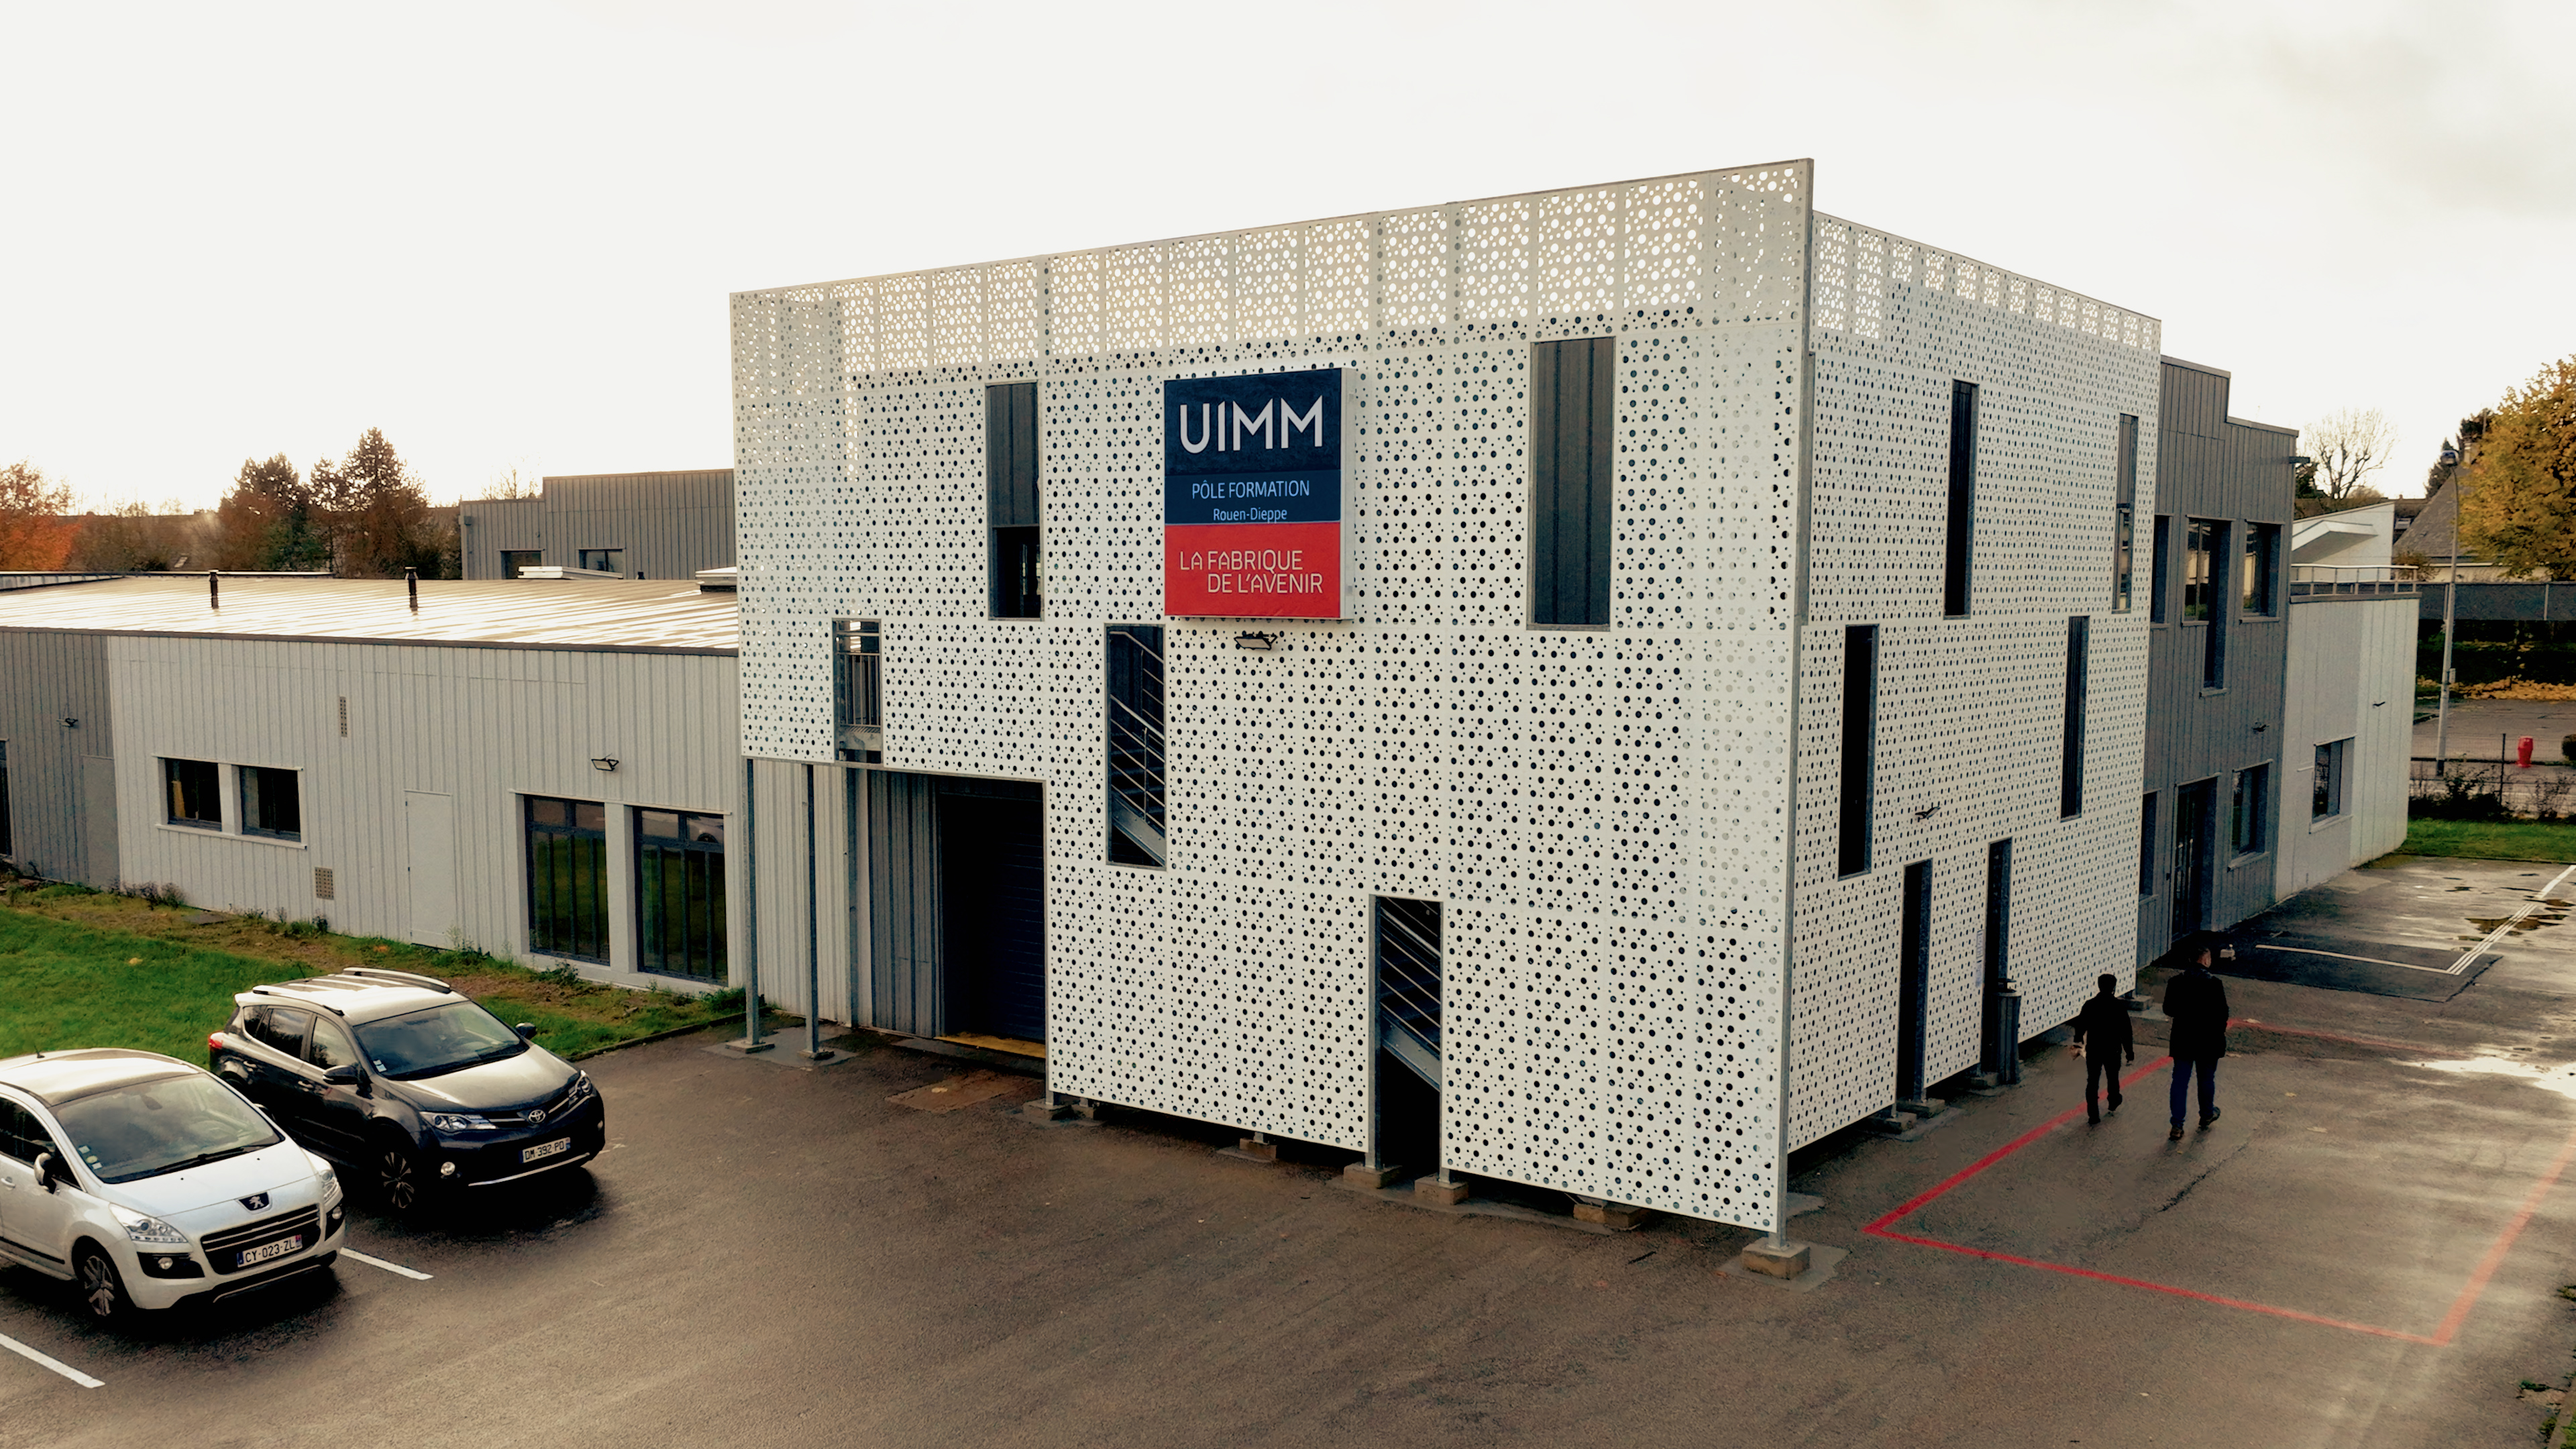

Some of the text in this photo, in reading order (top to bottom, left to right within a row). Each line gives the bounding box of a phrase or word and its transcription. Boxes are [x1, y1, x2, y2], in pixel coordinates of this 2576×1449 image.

[1180, 394, 1323, 454] UIMM
[1192, 480, 1309, 499] PÔLE FORMATION
[1213, 507, 1287, 524] Rouen-Dieppe
[1180, 549, 1303, 574] LA FABRIQUE
[1208, 573, 1323, 594] DE L'AVENIR
[245, 1239, 295, 1263] CY-023-ZL
